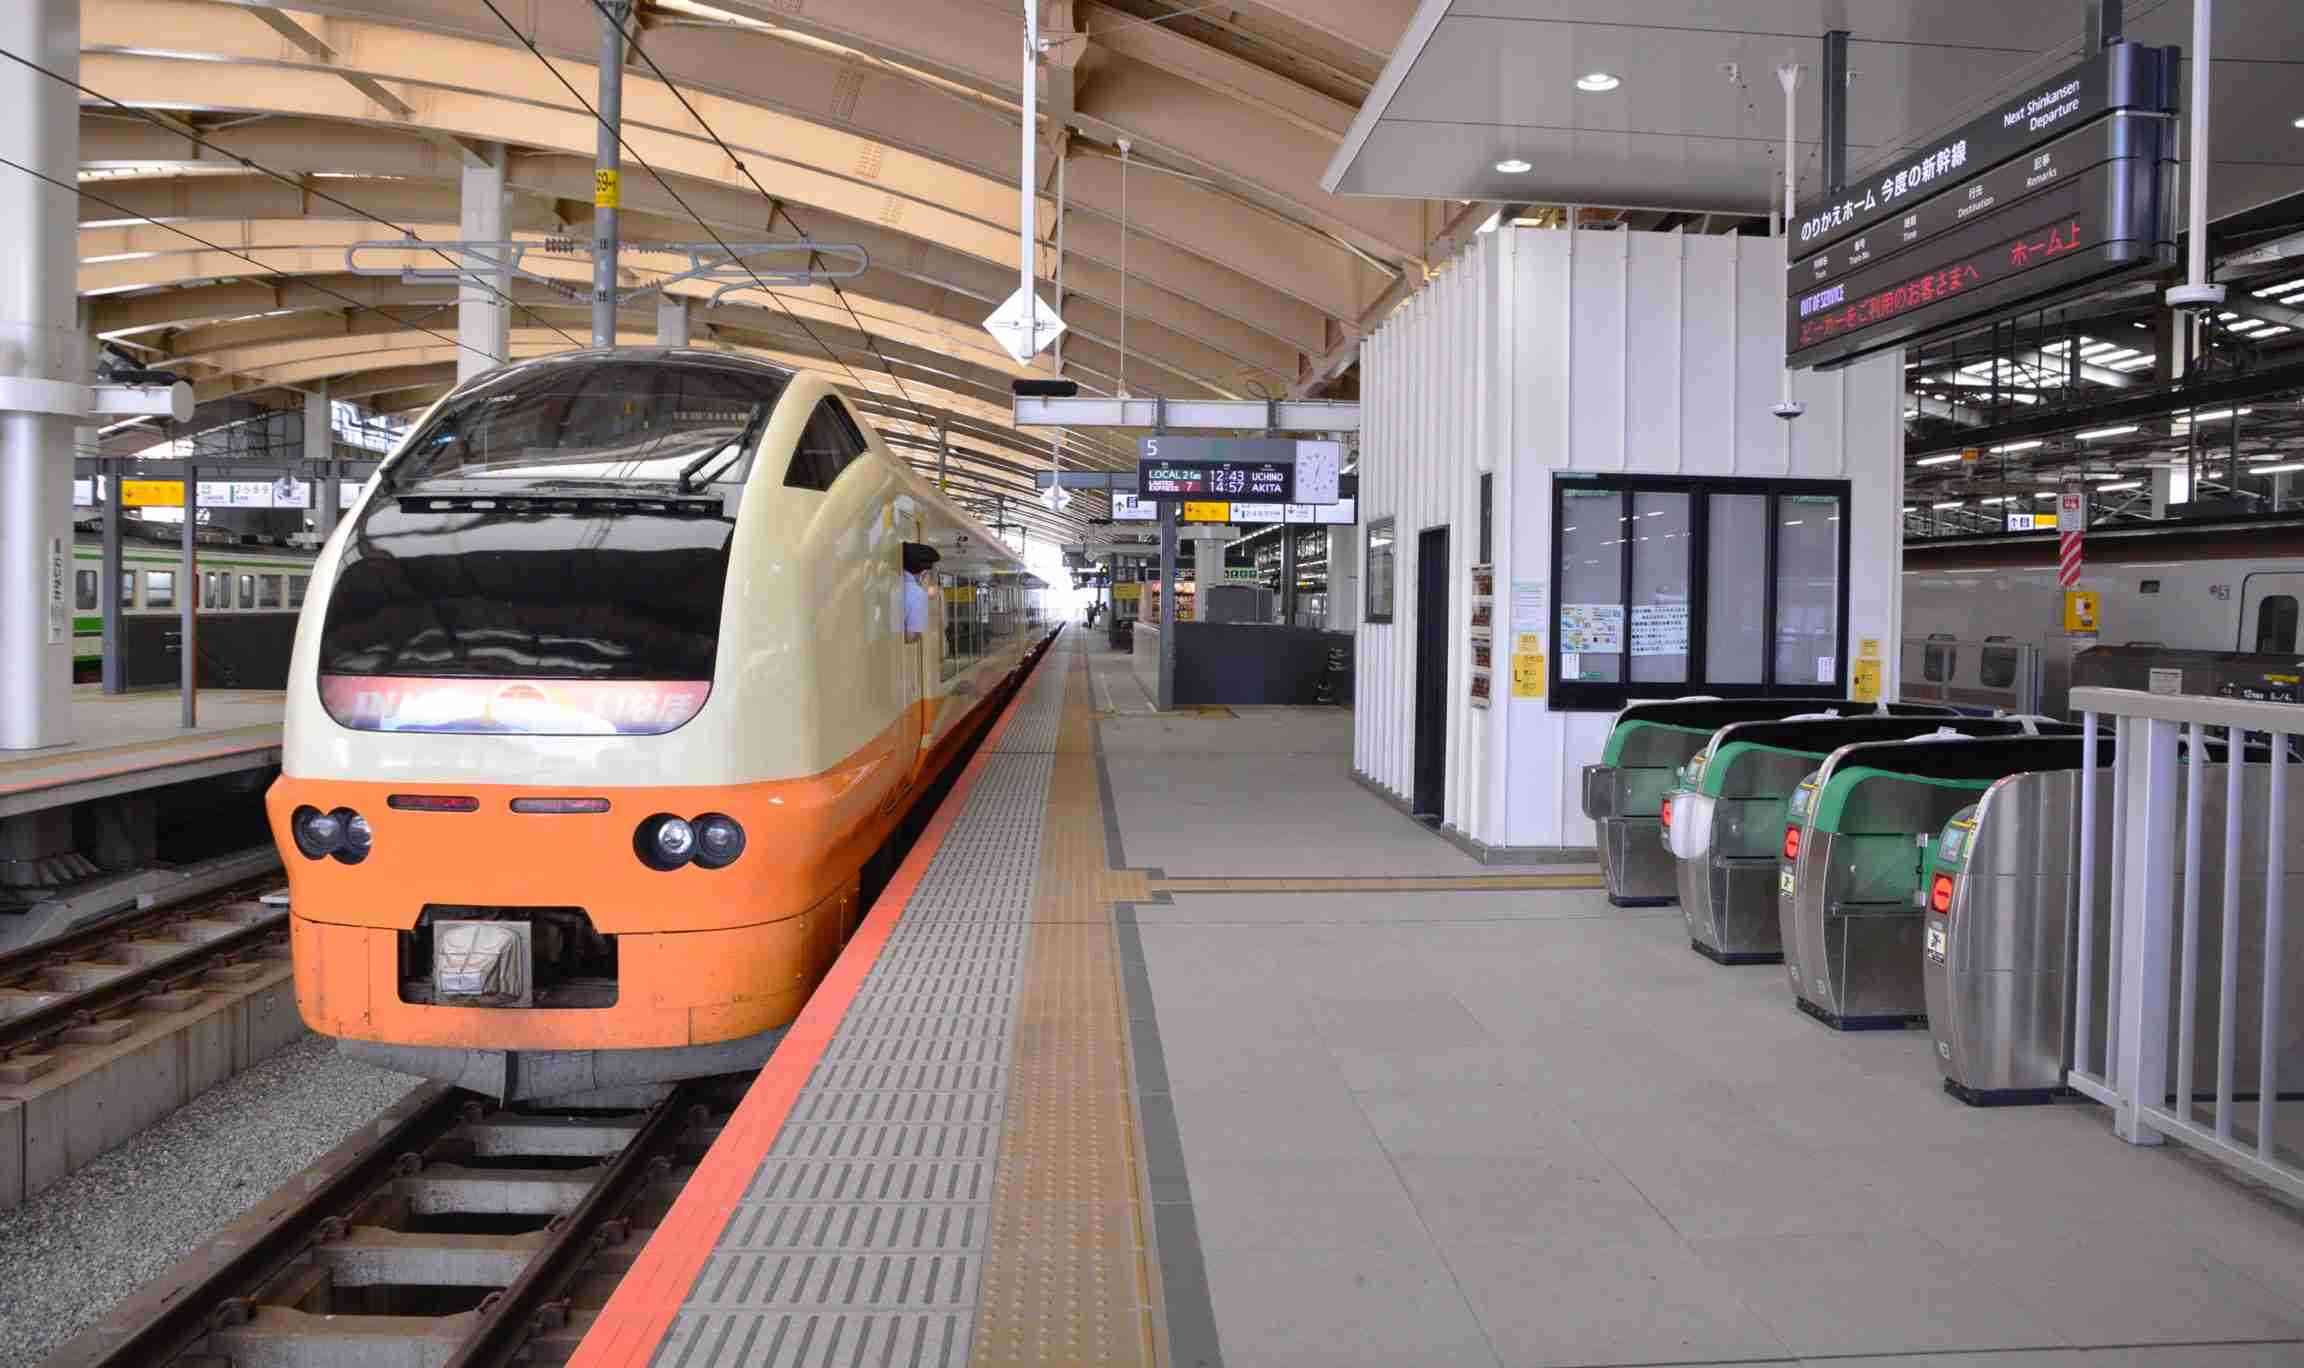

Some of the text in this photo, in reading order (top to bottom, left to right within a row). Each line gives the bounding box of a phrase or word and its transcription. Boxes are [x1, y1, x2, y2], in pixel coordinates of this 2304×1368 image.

[2004, 79, 2080, 128] Next Shinkansen
[2030, 98, 2080, 131] Departure
[1800, 139, 1967, 241] のりかえホーム 今度の新幹線
[2026, 167, 2057, 188] Remarks
[2009, 221, 2080, 265] ホーム上
[1147, 440, 1158, 456] 5
[1149, 470, 1181, 480] LOCAL
[1210, 470, 1245, 482] 12:43
[1251, 472, 1284, 482] UCHINO
[1185, 481, 1193, 492] 7
[1210, 481, 1245, 493] 14:57
[1251, 483, 1283, 493] AKITA
